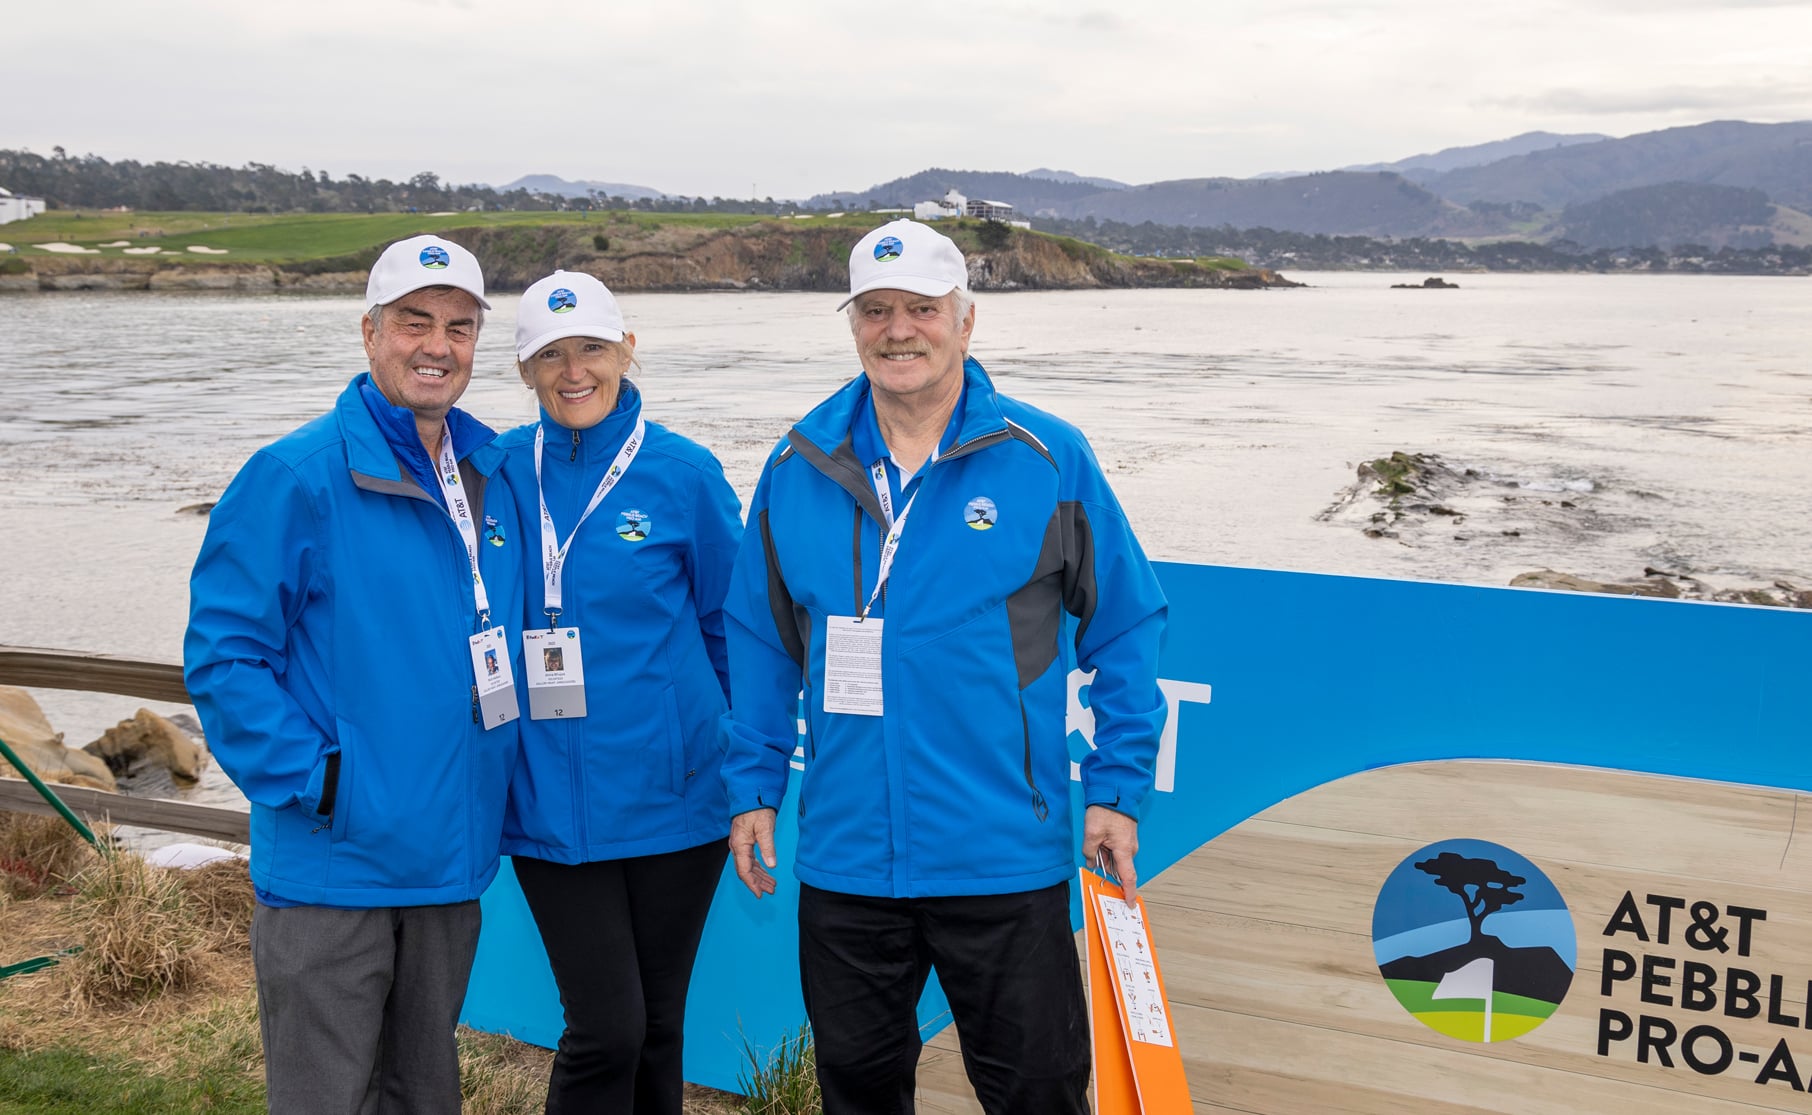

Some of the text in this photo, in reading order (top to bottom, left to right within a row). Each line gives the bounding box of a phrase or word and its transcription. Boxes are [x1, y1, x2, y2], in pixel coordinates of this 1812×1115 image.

[625, 438, 637, 458] AT&T
[455, 498, 468, 518] AT&T
[554, 709, 564, 717] 12
[1602, 890, 1767, 957] AT&T
[1600, 948, 1812, 1030] PEBBL
[1597, 1008, 1812, 1093] PRO-A
